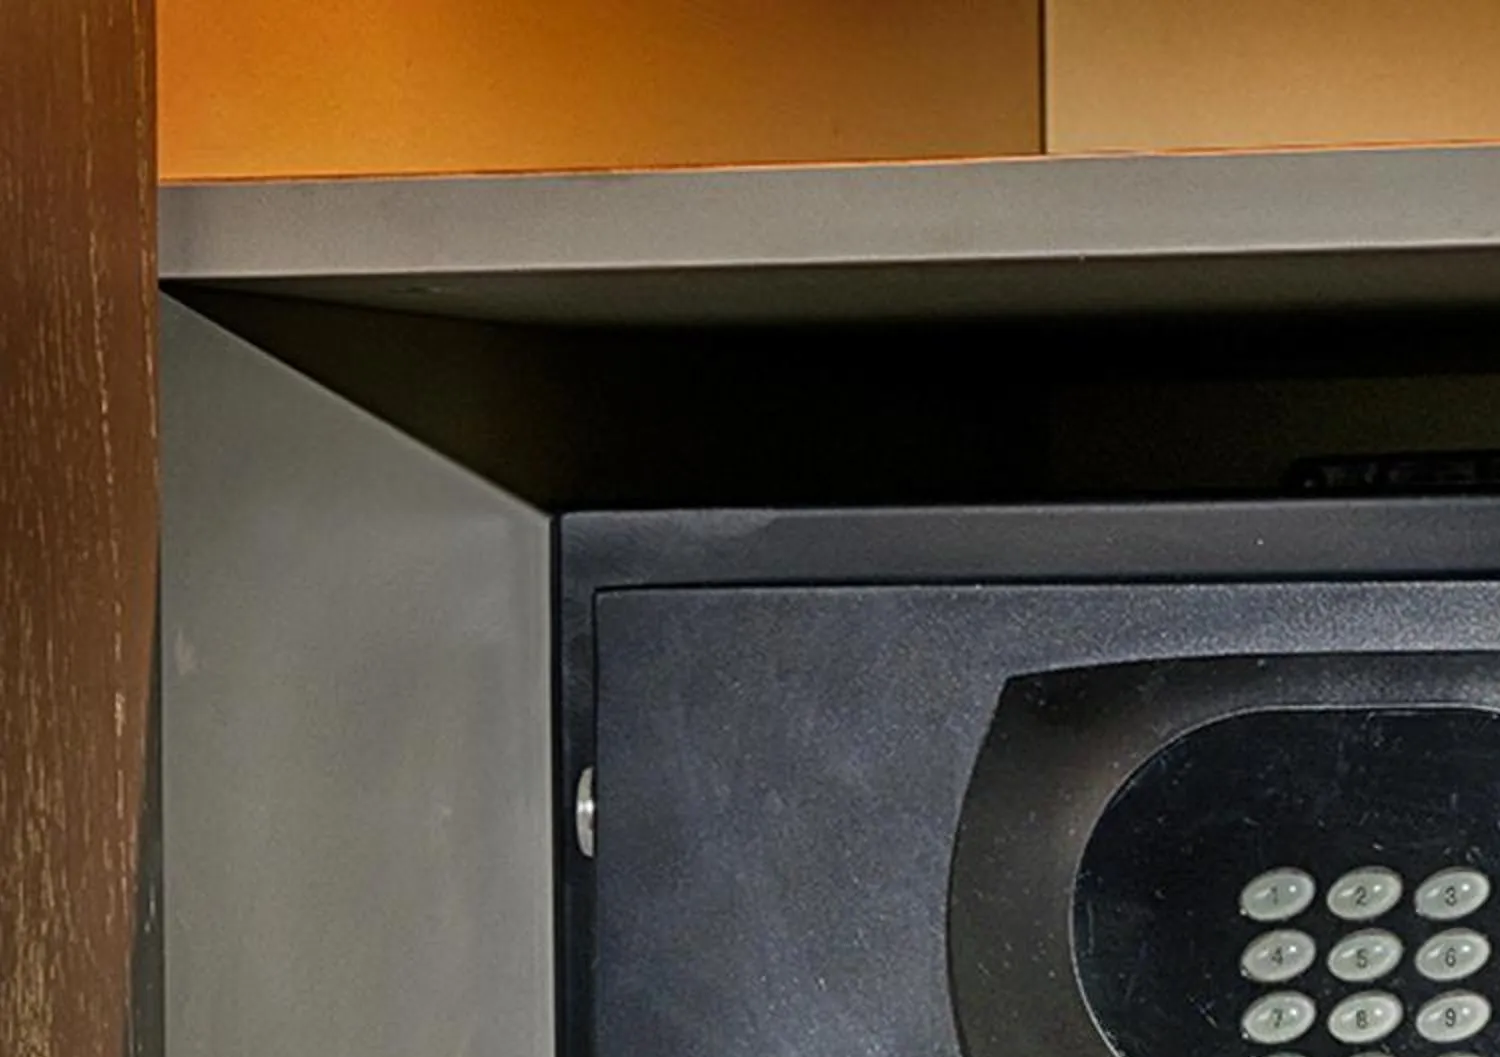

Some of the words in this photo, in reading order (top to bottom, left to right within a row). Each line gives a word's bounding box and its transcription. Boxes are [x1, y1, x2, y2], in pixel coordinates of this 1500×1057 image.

[1355, 886, 1367, 906] 2
[1444, 887, 1456, 906] 3
[1272, 947, 1283, 966] 4
[1356, 948, 1368, 968] 5
[1445, 947, 1456, 967] 6
[1272, 1008, 1284, 1028] 7
[1356, 1010, 1367, 1029] 8
[1445, 1008, 1456, 1027] 9
